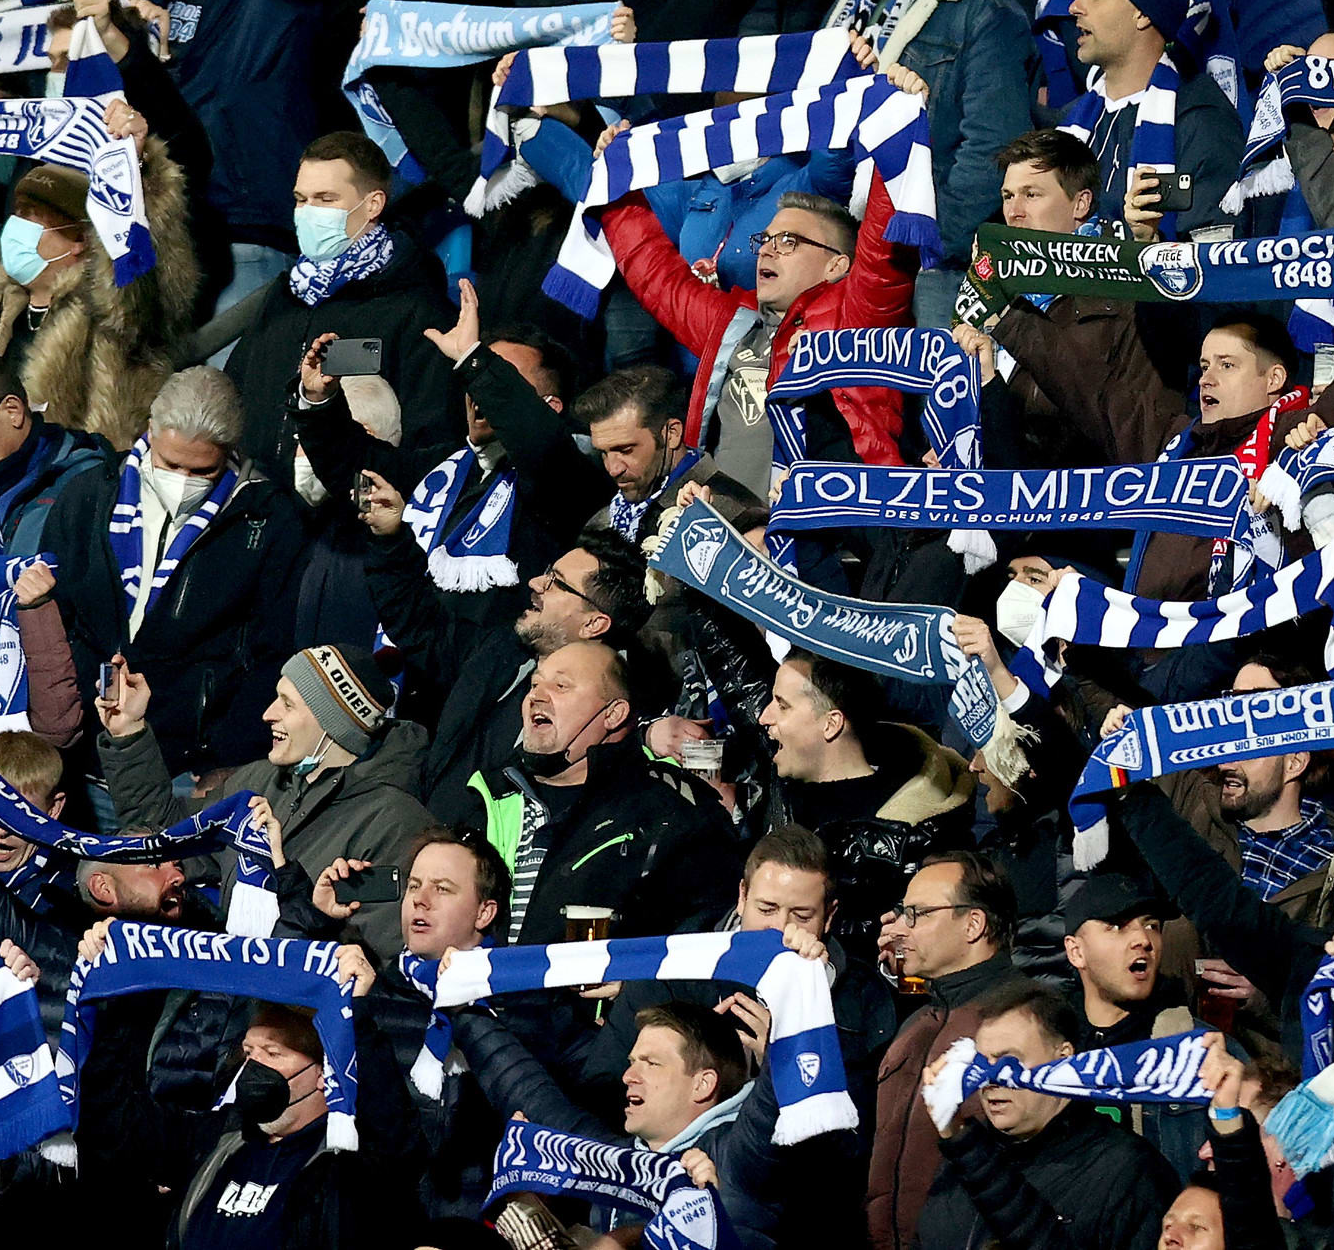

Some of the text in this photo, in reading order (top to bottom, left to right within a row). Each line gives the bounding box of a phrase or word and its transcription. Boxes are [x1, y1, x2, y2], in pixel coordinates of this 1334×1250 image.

[1047, 240, 1120, 264] HERZEN
[998, 257, 1049, 278] UND
[1271, 261, 1333, 289] 1848
[791, 330, 912, 373] BOCHUM
[1010, 463, 1248, 511] MITGLIED
[884, 509, 1104, 525] DES VfL BOCHUM 1848
[328, 666, 373, 721] OGIER
[1163, 681, 1334, 736] Bochum
[122, 923, 289, 966] REVIER IST
[667, 1195, 709, 1218] Bochum
[681, 1206, 708, 1225] 1848
